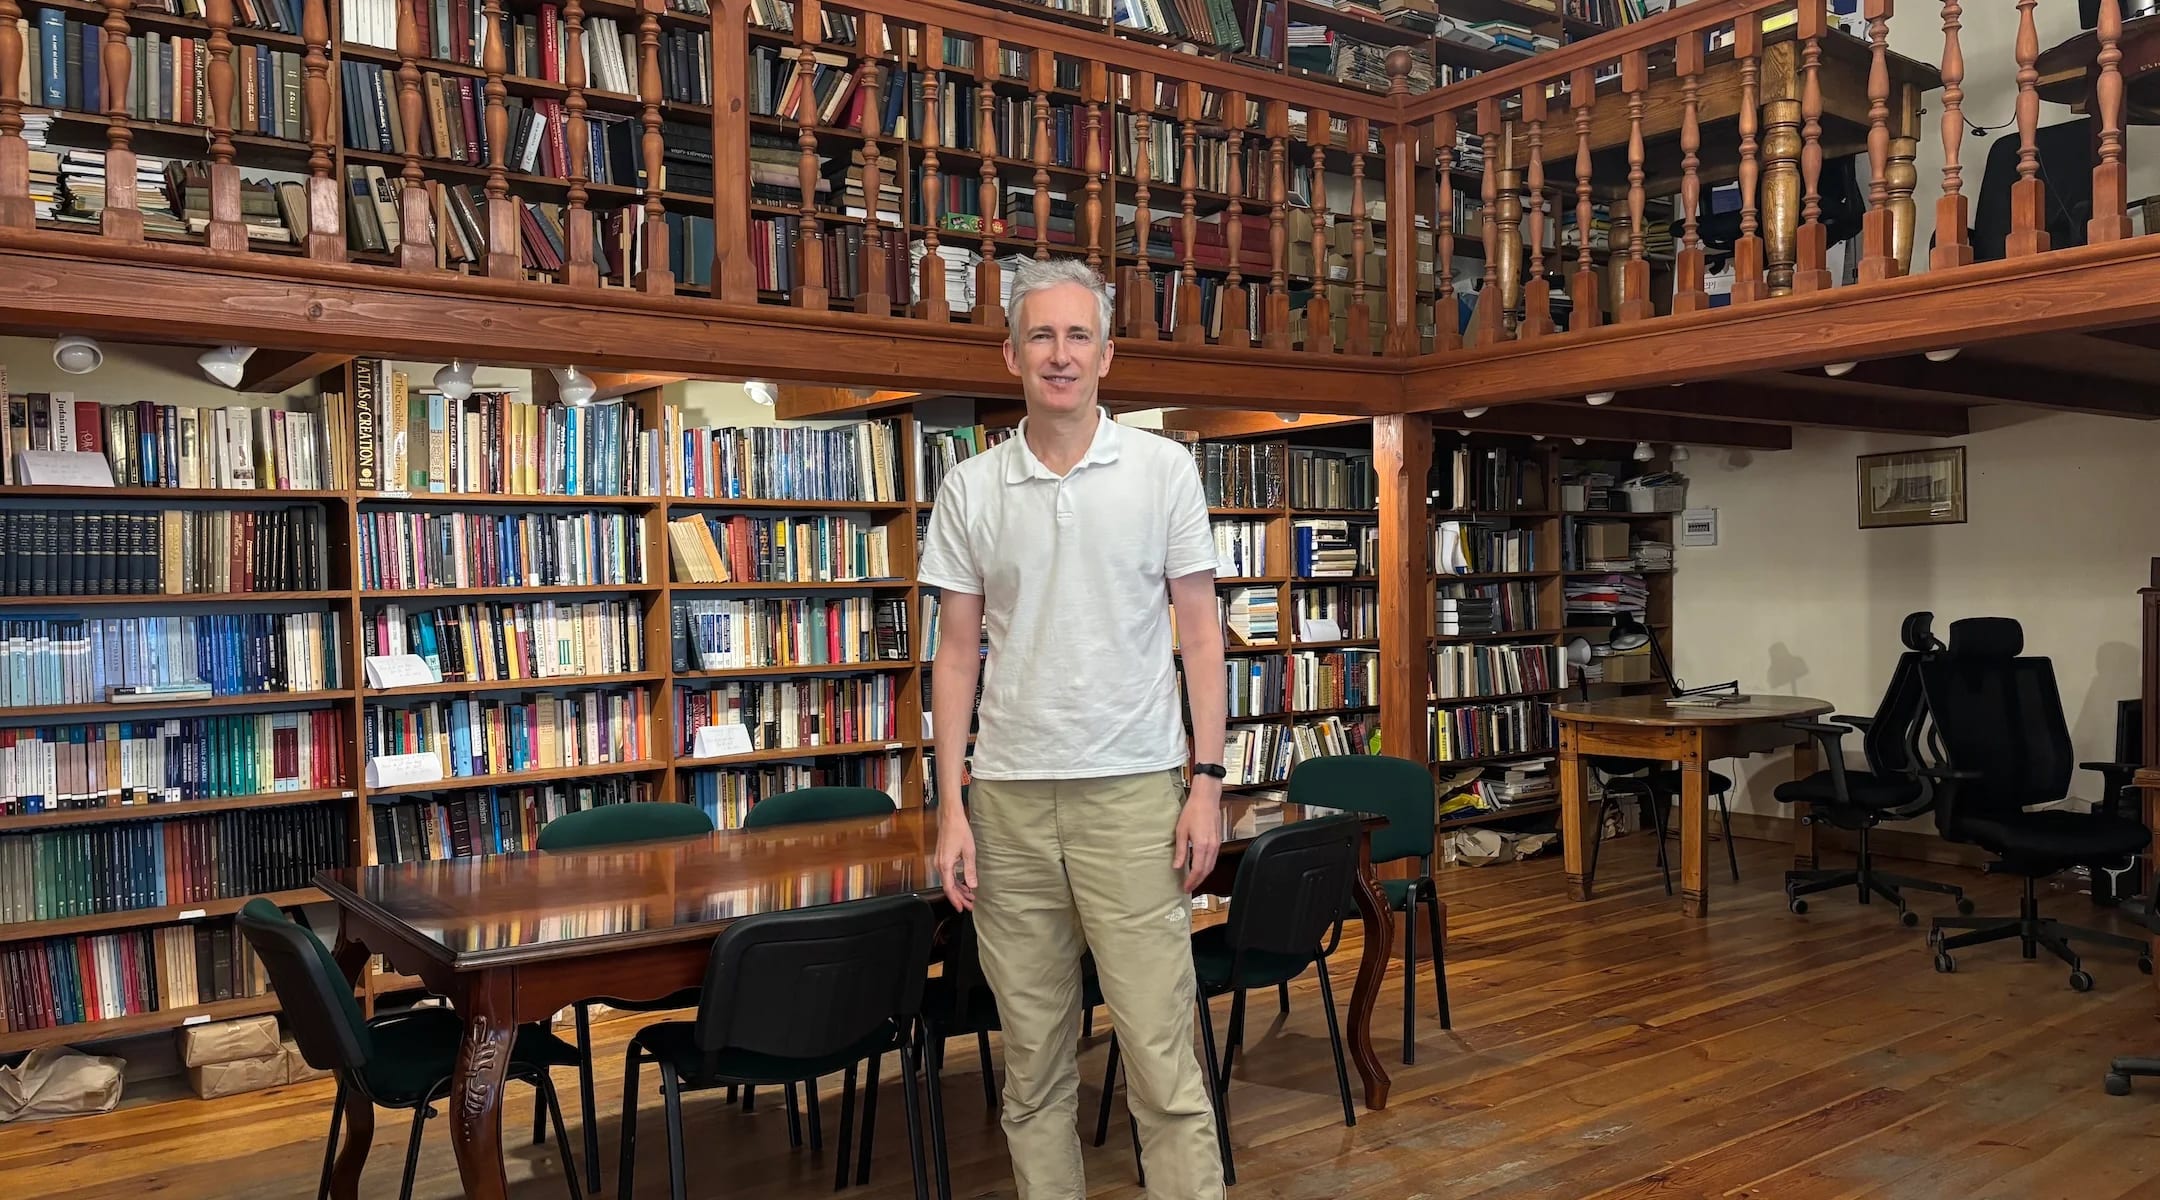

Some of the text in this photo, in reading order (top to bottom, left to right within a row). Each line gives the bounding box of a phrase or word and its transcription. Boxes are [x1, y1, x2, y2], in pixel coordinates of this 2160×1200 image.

[395, 379, 403, 393] The
[56, 398, 68, 434] Judaism
[357, 365, 374, 466] ATLAS of CREATION
[395, 393, 403, 427] Crucible
[478, 793, 489, 825] Judaism
